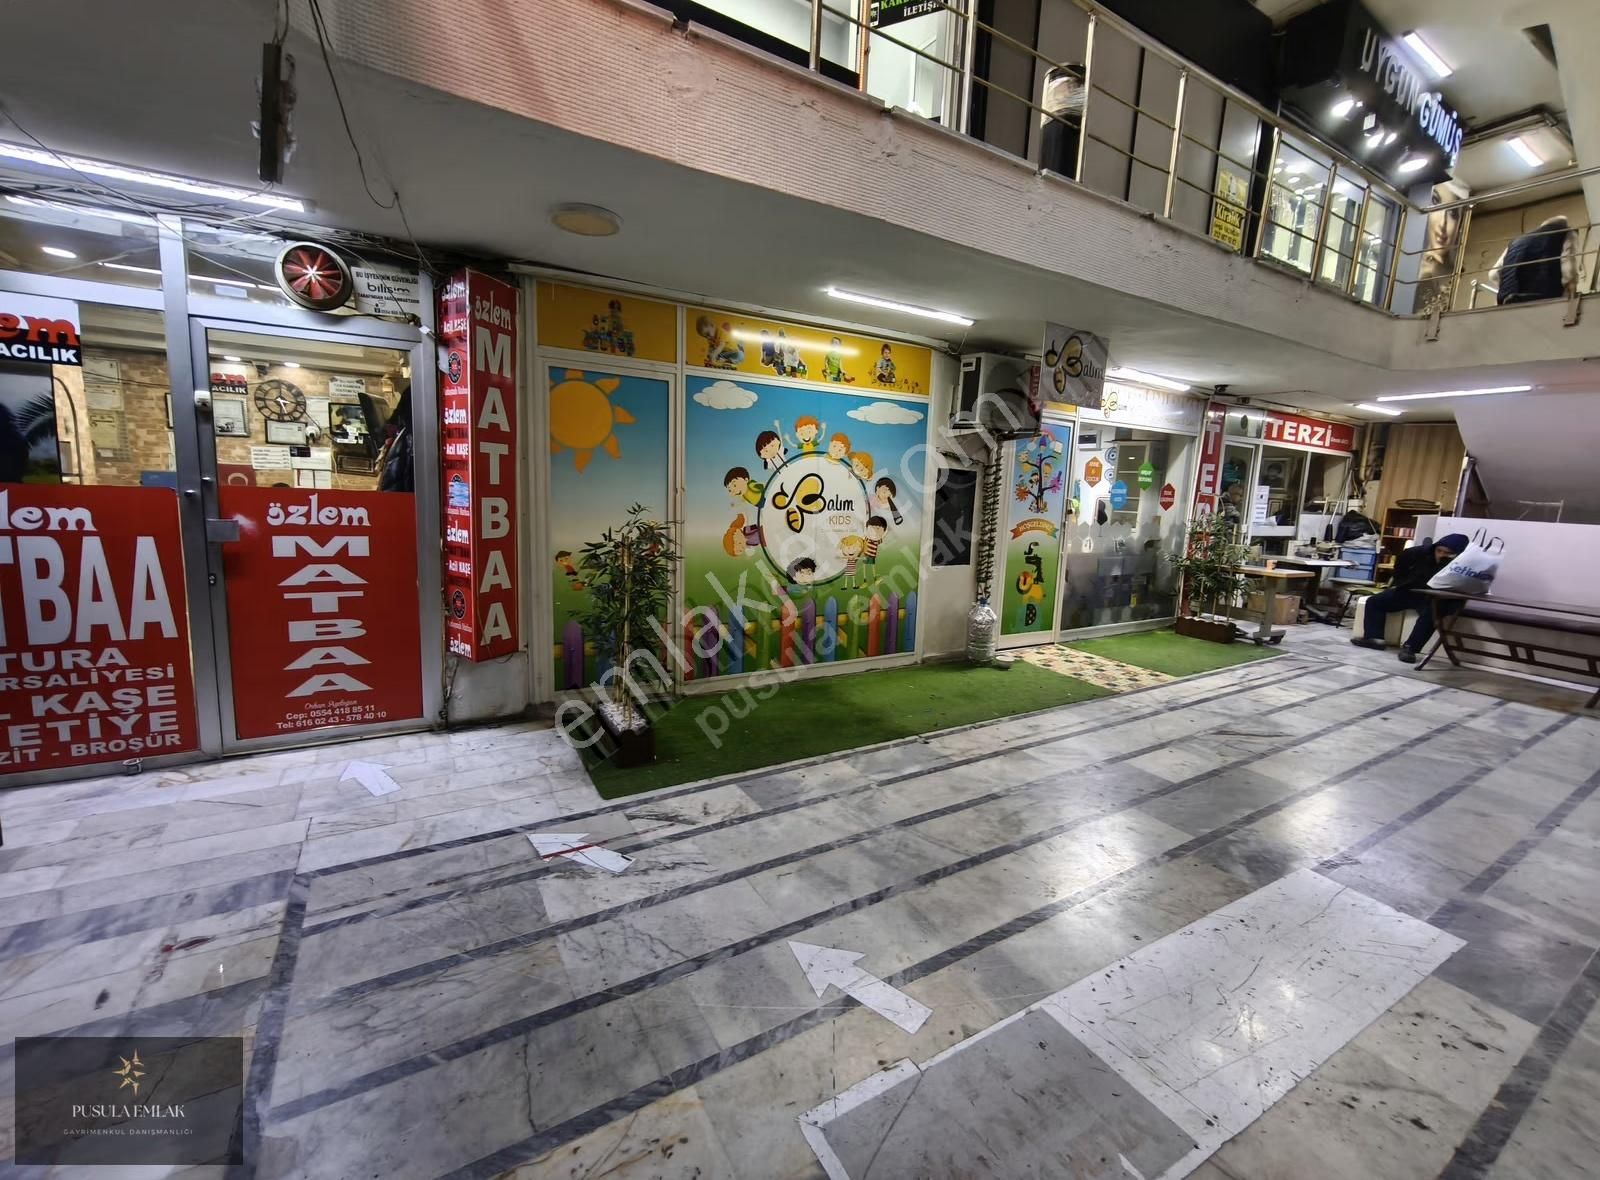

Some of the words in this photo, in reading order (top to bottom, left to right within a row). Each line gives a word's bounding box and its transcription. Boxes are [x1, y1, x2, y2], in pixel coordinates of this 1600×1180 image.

[1360, 27, 1420, 116] UYGUN
[475, 290, 512, 330] özlem
[444, 400, 467, 425] özlem
[1270, 418, 1333, 447] TERZİ
[475, 325, 513, 647] MATBAA
[267, 493, 372, 527] özlem
[828, 515, 852, 525] KIDS
[447, 520, 470, 545] özlem
[459, 561, 471, 577] KAŞE
[271, 535, 375, 698] MATBAA
[450, 633, 472, 658] özlem
[31, 685, 177, 715] KAŞE
[286, 711, 308, 721] Cep:
[310, 709, 332, 718] 0554
[364, 704, 375, 712] 11
[8, 710, 179, 747] ETİYE
[276, 720, 294, 729] Tel:
[315, 717, 327, 726] 02
[328, 715, 339, 723] 43
[346, 713, 362, 722] 578
[377, 710, 387, 718] 10
[70, 733, 182, 757] BROŞÜR
